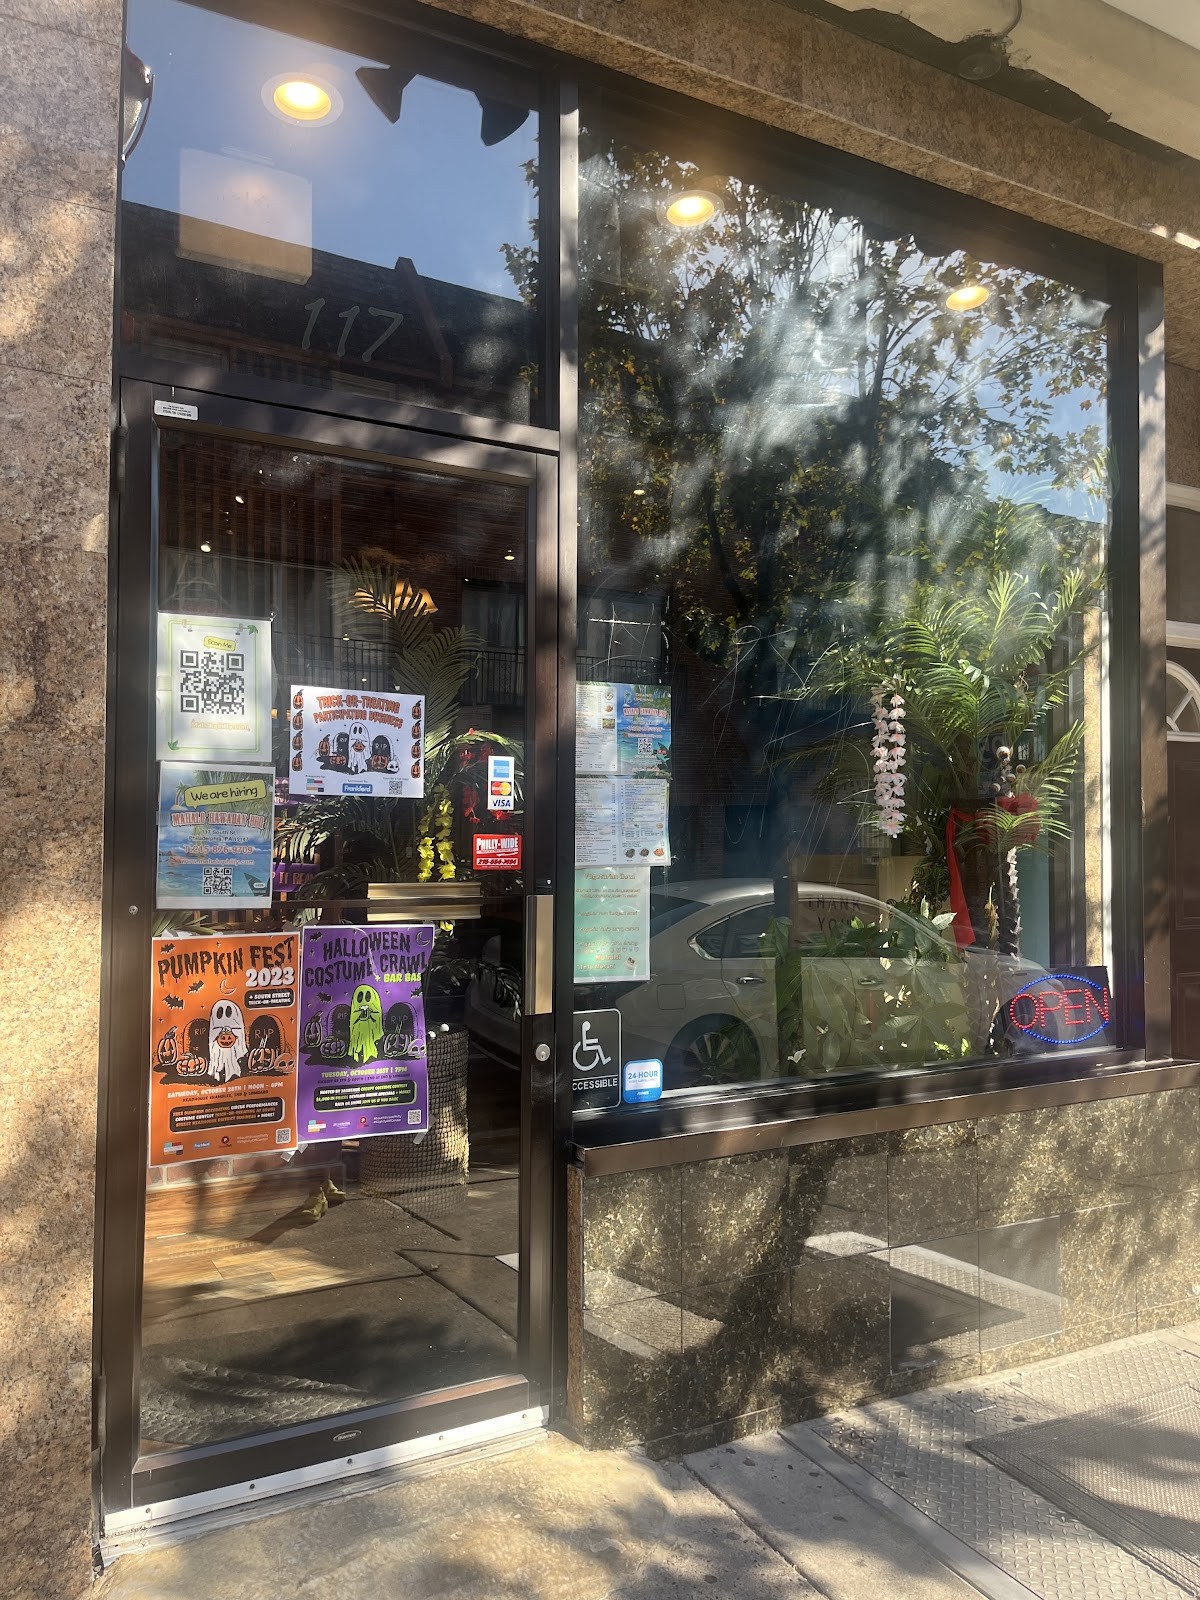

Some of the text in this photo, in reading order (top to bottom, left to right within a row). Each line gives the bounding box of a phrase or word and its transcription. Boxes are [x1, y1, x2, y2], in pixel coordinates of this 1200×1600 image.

[305, 298, 403, 362] 117
[208, 638, 221, 646] Scan
[316, 694, 401, 714] TRICK-OR-TREATING
[313, 709, 367, 724] PARTICIPATING
[190, 786, 258, 802] We are hiring
[344, 784, 372, 793] Frankford
[493, 800, 511, 808] VISA
[476, 837, 519, 850] PHILLY-WIDE
[324, 931, 411, 962] HALLOWEEN
[158, 936, 294, 987] PUMPKIN FEST
[246, 966, 295, 988] 2023
[305, 956, 376, 988] COSTUME
[384, 972, 402, 982] BAR
[405, 972, 422, 982] BAS
[1010, 986, 1110, 1030] OPEN
[194, 1028, 206, 1036] RIP
[254, 1028, 274, 1039] RIP
[628, 1070, 658, 1080] 24-HOUR
[572, 1078, 618, 1091] CCESSIBLE
[168, 1090, 200, 1098] SATURDAY,
[201, 1087, 226, 1095] OCTOBER
